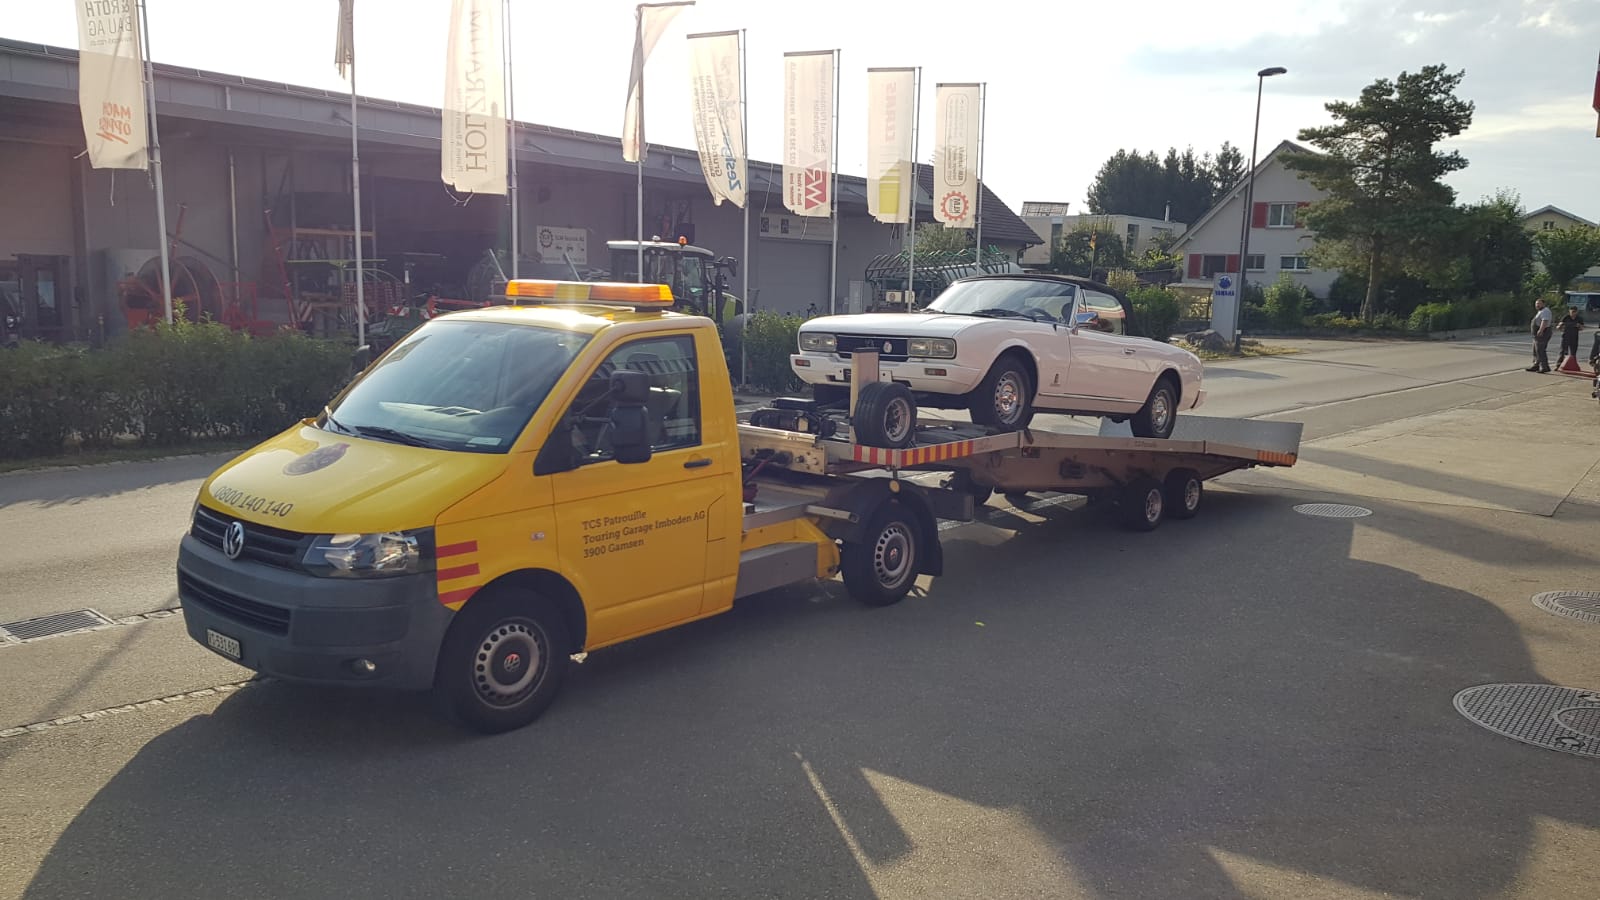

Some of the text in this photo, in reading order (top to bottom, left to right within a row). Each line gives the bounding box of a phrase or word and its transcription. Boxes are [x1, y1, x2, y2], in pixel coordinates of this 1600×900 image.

[214, 485, 294, 517] 0800 140 140
[582, 510, 647, 531] TCS Patrouille
[582, 510, 706, 544] Touring Garage Imboden AG
[583, 538, 644, 559] 3900 Gamsen
